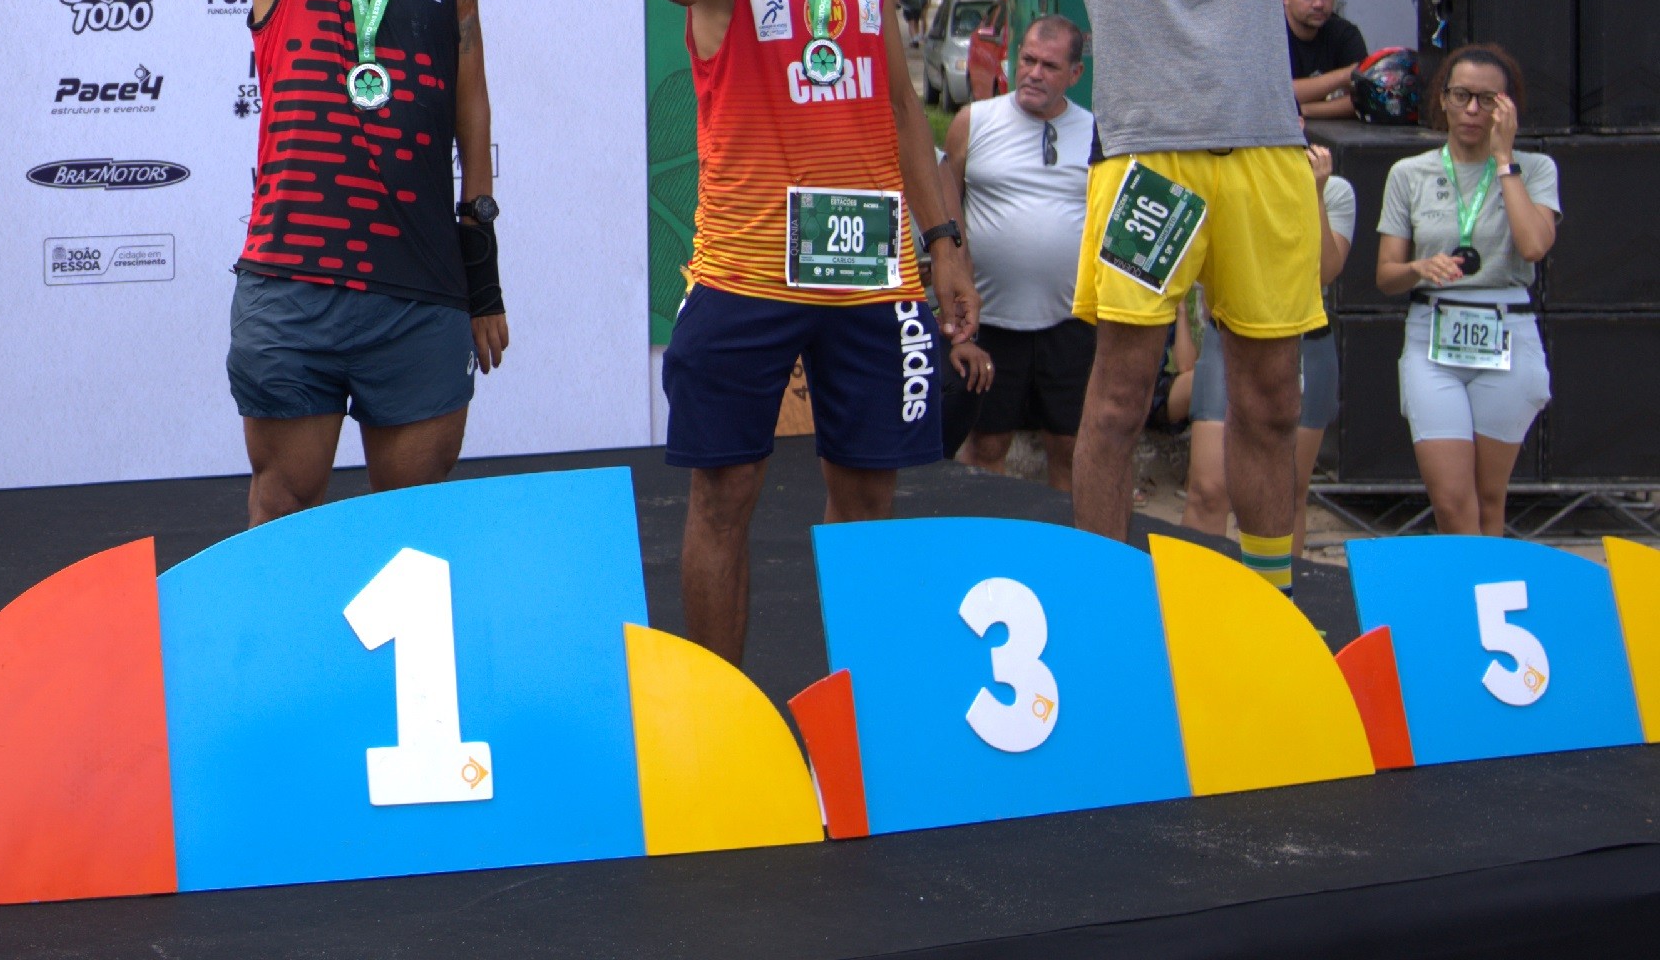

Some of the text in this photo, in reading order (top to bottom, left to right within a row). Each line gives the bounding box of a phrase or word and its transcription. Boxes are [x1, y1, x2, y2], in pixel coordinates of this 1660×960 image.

[71, 0, 154, 35] TODO
[54, 74, 164, 102] Pace4
[51, 104, 156, 115] estrutura e eventos
[827, 214, 864, 253] 298
[1124, 195, 1169, 242] 316
[52, 261, 101, 273] PESSOA
[67, 246, 101, 261] JOÃO
[113, 257, 167, 267] crescimento
[118, 250, 146, 260] cidade
[1452, 321, 1489, 346] 2162
[894, 301, 934, 422] adidas
[1473, 579, 1551, 709] 5
[343, 547, 493, 806] 1
[957, 576, 1061, 754] 3
